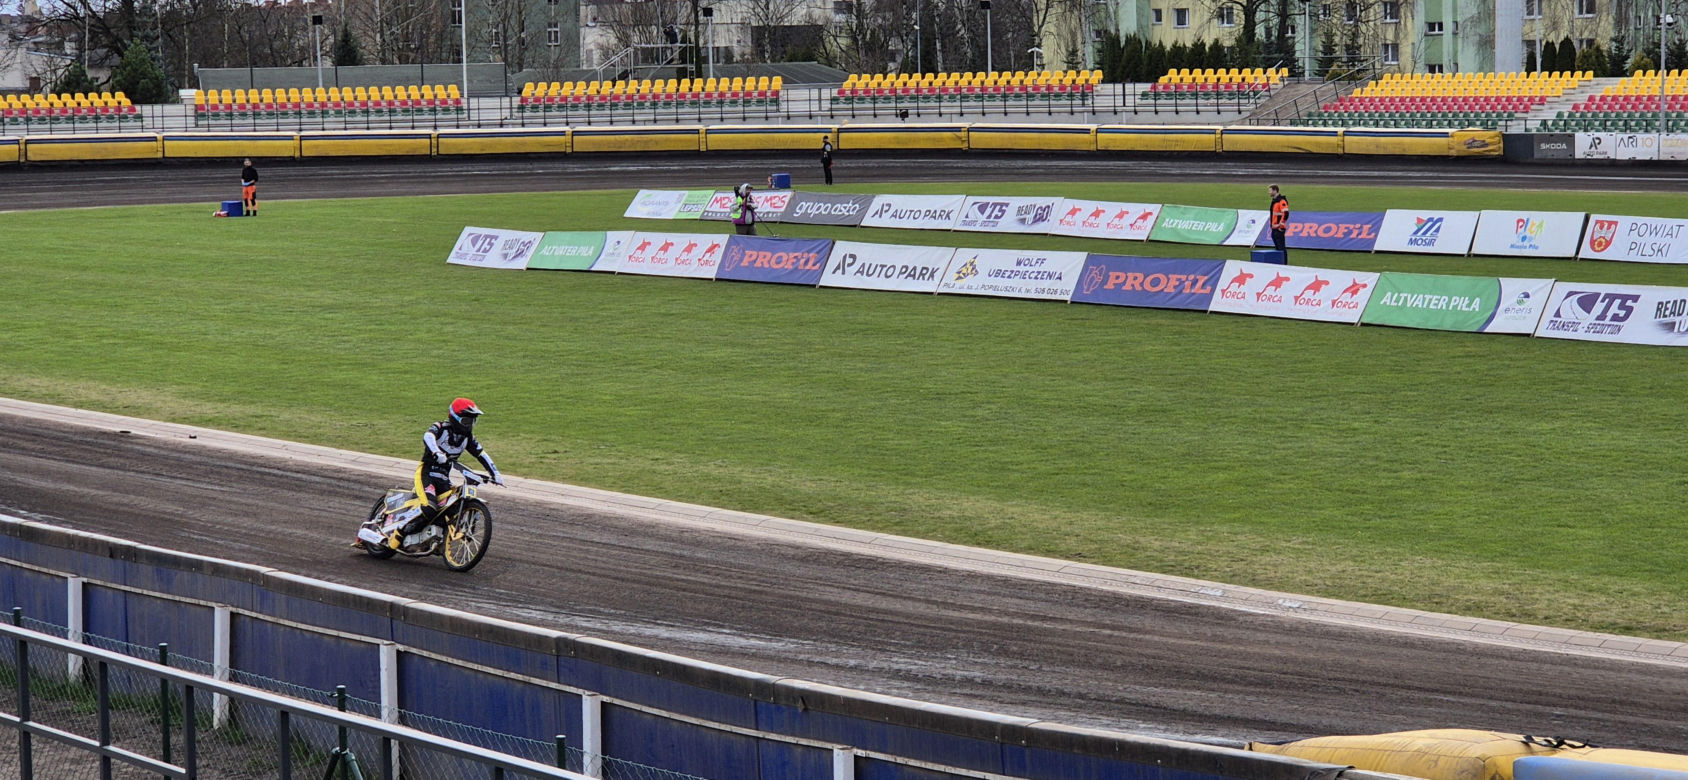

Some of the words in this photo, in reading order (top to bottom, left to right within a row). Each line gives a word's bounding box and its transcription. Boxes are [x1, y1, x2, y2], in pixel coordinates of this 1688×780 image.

[793, 201, 829, 218] grupa
[831, 200, 860, 215] asta
[890, 208, 922, 220] AUTO
[923, 209, 954, 221] PARK
[986, 203, 1010, 220] TS
[1016, 203, 1036, 217] READY
[1162, 218, 1205, 231] ALTVATER
[1628, 222, 1685, 239] POWIAT
[475, 234, 499, 253] TS
[1627, 241, 1671, 257] PILSKI
[1016, 257, 1046, 267] WOLFF
[854, 263, 897, 279] AUTO
[897, 264, 940, 281] PARK
[988, 269, 1063, 281] UBEZPIECZENIA
[1225, 290, 1246, 300] ORCA
[1260, 294, 1282, 303] ORCA
[1298, 297, 1322, 307] ORCA
[1380, 291, 1450, 310] ALTVATER
[1450, 295, 1481, 311] PIŁA
[1335, 300, 1359, 309] ORCA
[1595, 293, 1642, 322] TS
[1654, 299, 1688, 320] READ
[1585, 322, 1625, 336] SPEDITION
